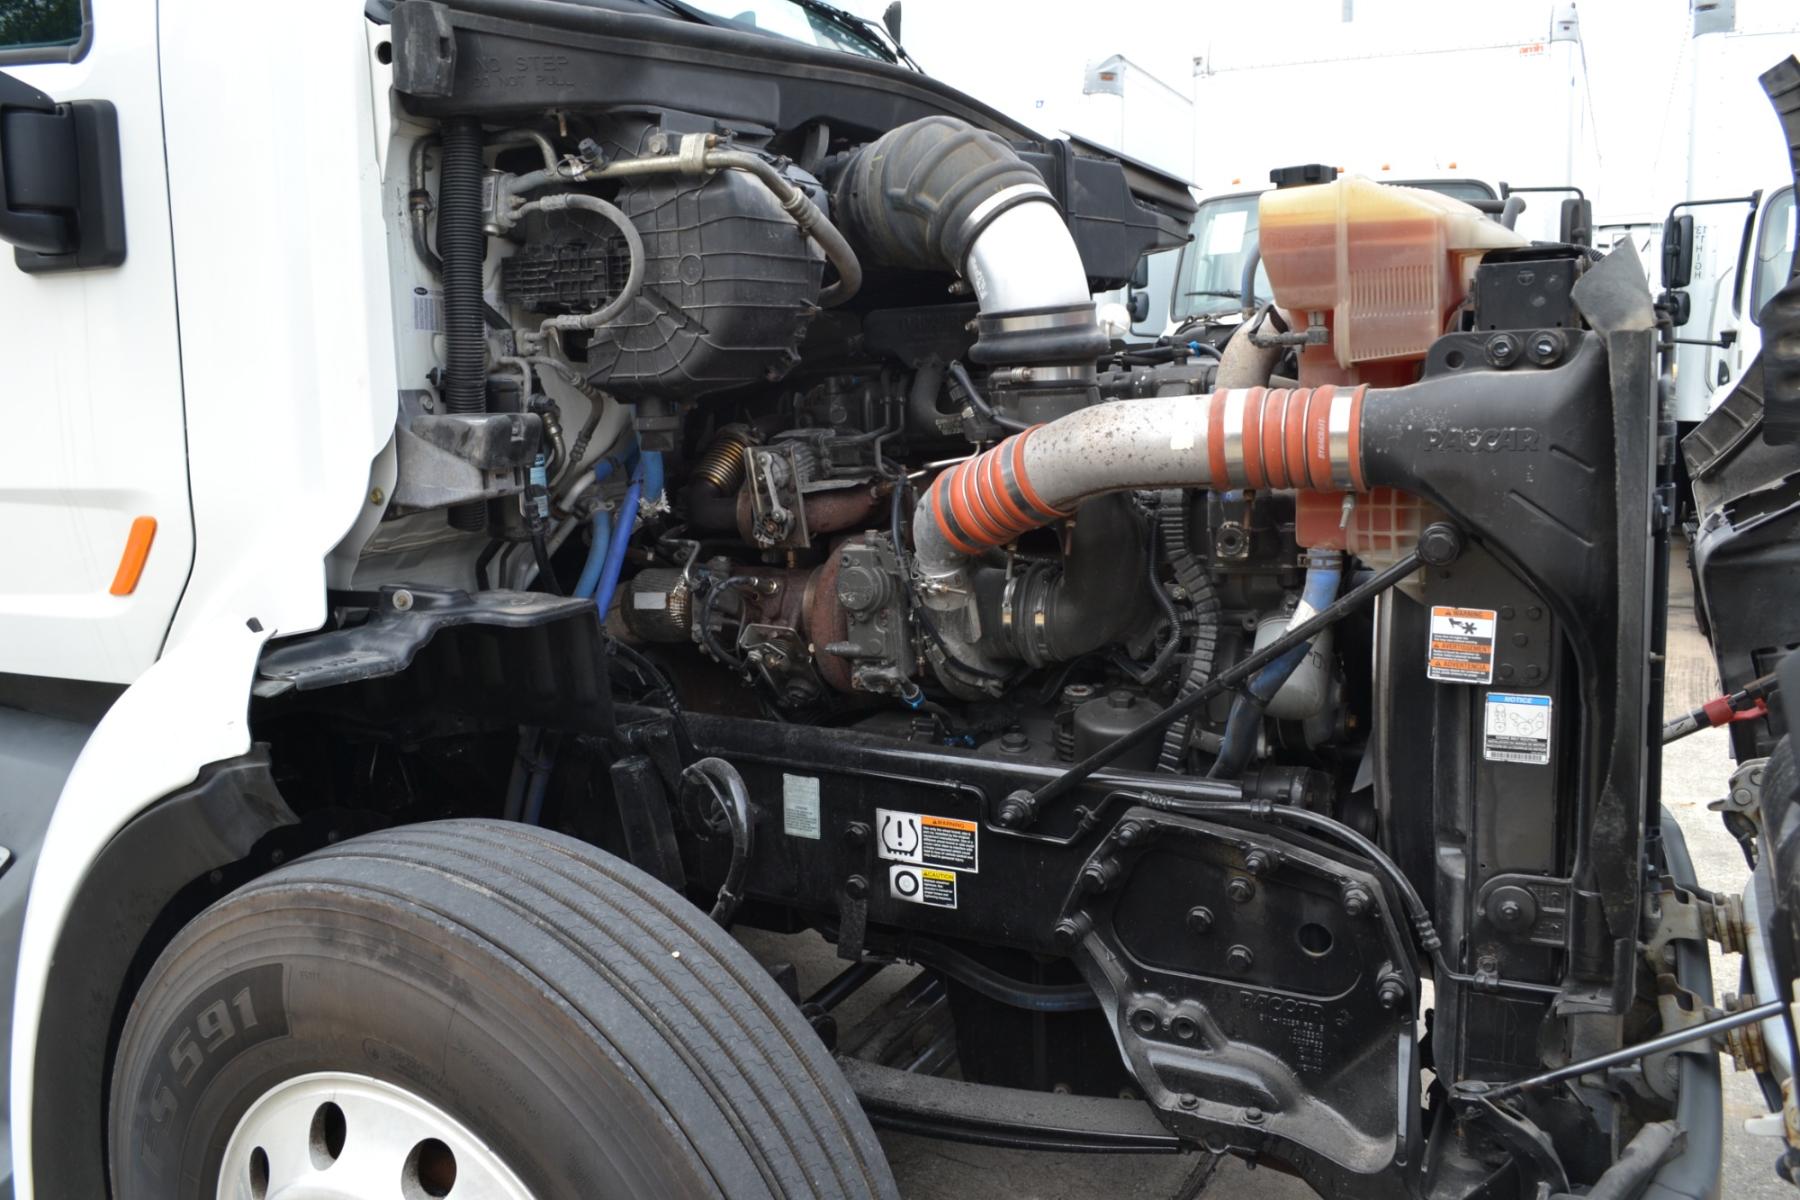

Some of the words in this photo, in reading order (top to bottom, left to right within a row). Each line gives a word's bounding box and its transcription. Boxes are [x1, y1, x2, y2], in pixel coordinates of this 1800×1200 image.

[474, 56, 500, 73] NO
[515, 55, 568, 72] STEP
[1423, 427, 1540, 453] PACCAR
[937, 820, 965, 829] WARNING
[927, 871, 954, 880] CAUTION
[1240, 990, 1324, 1020] PACCAR
